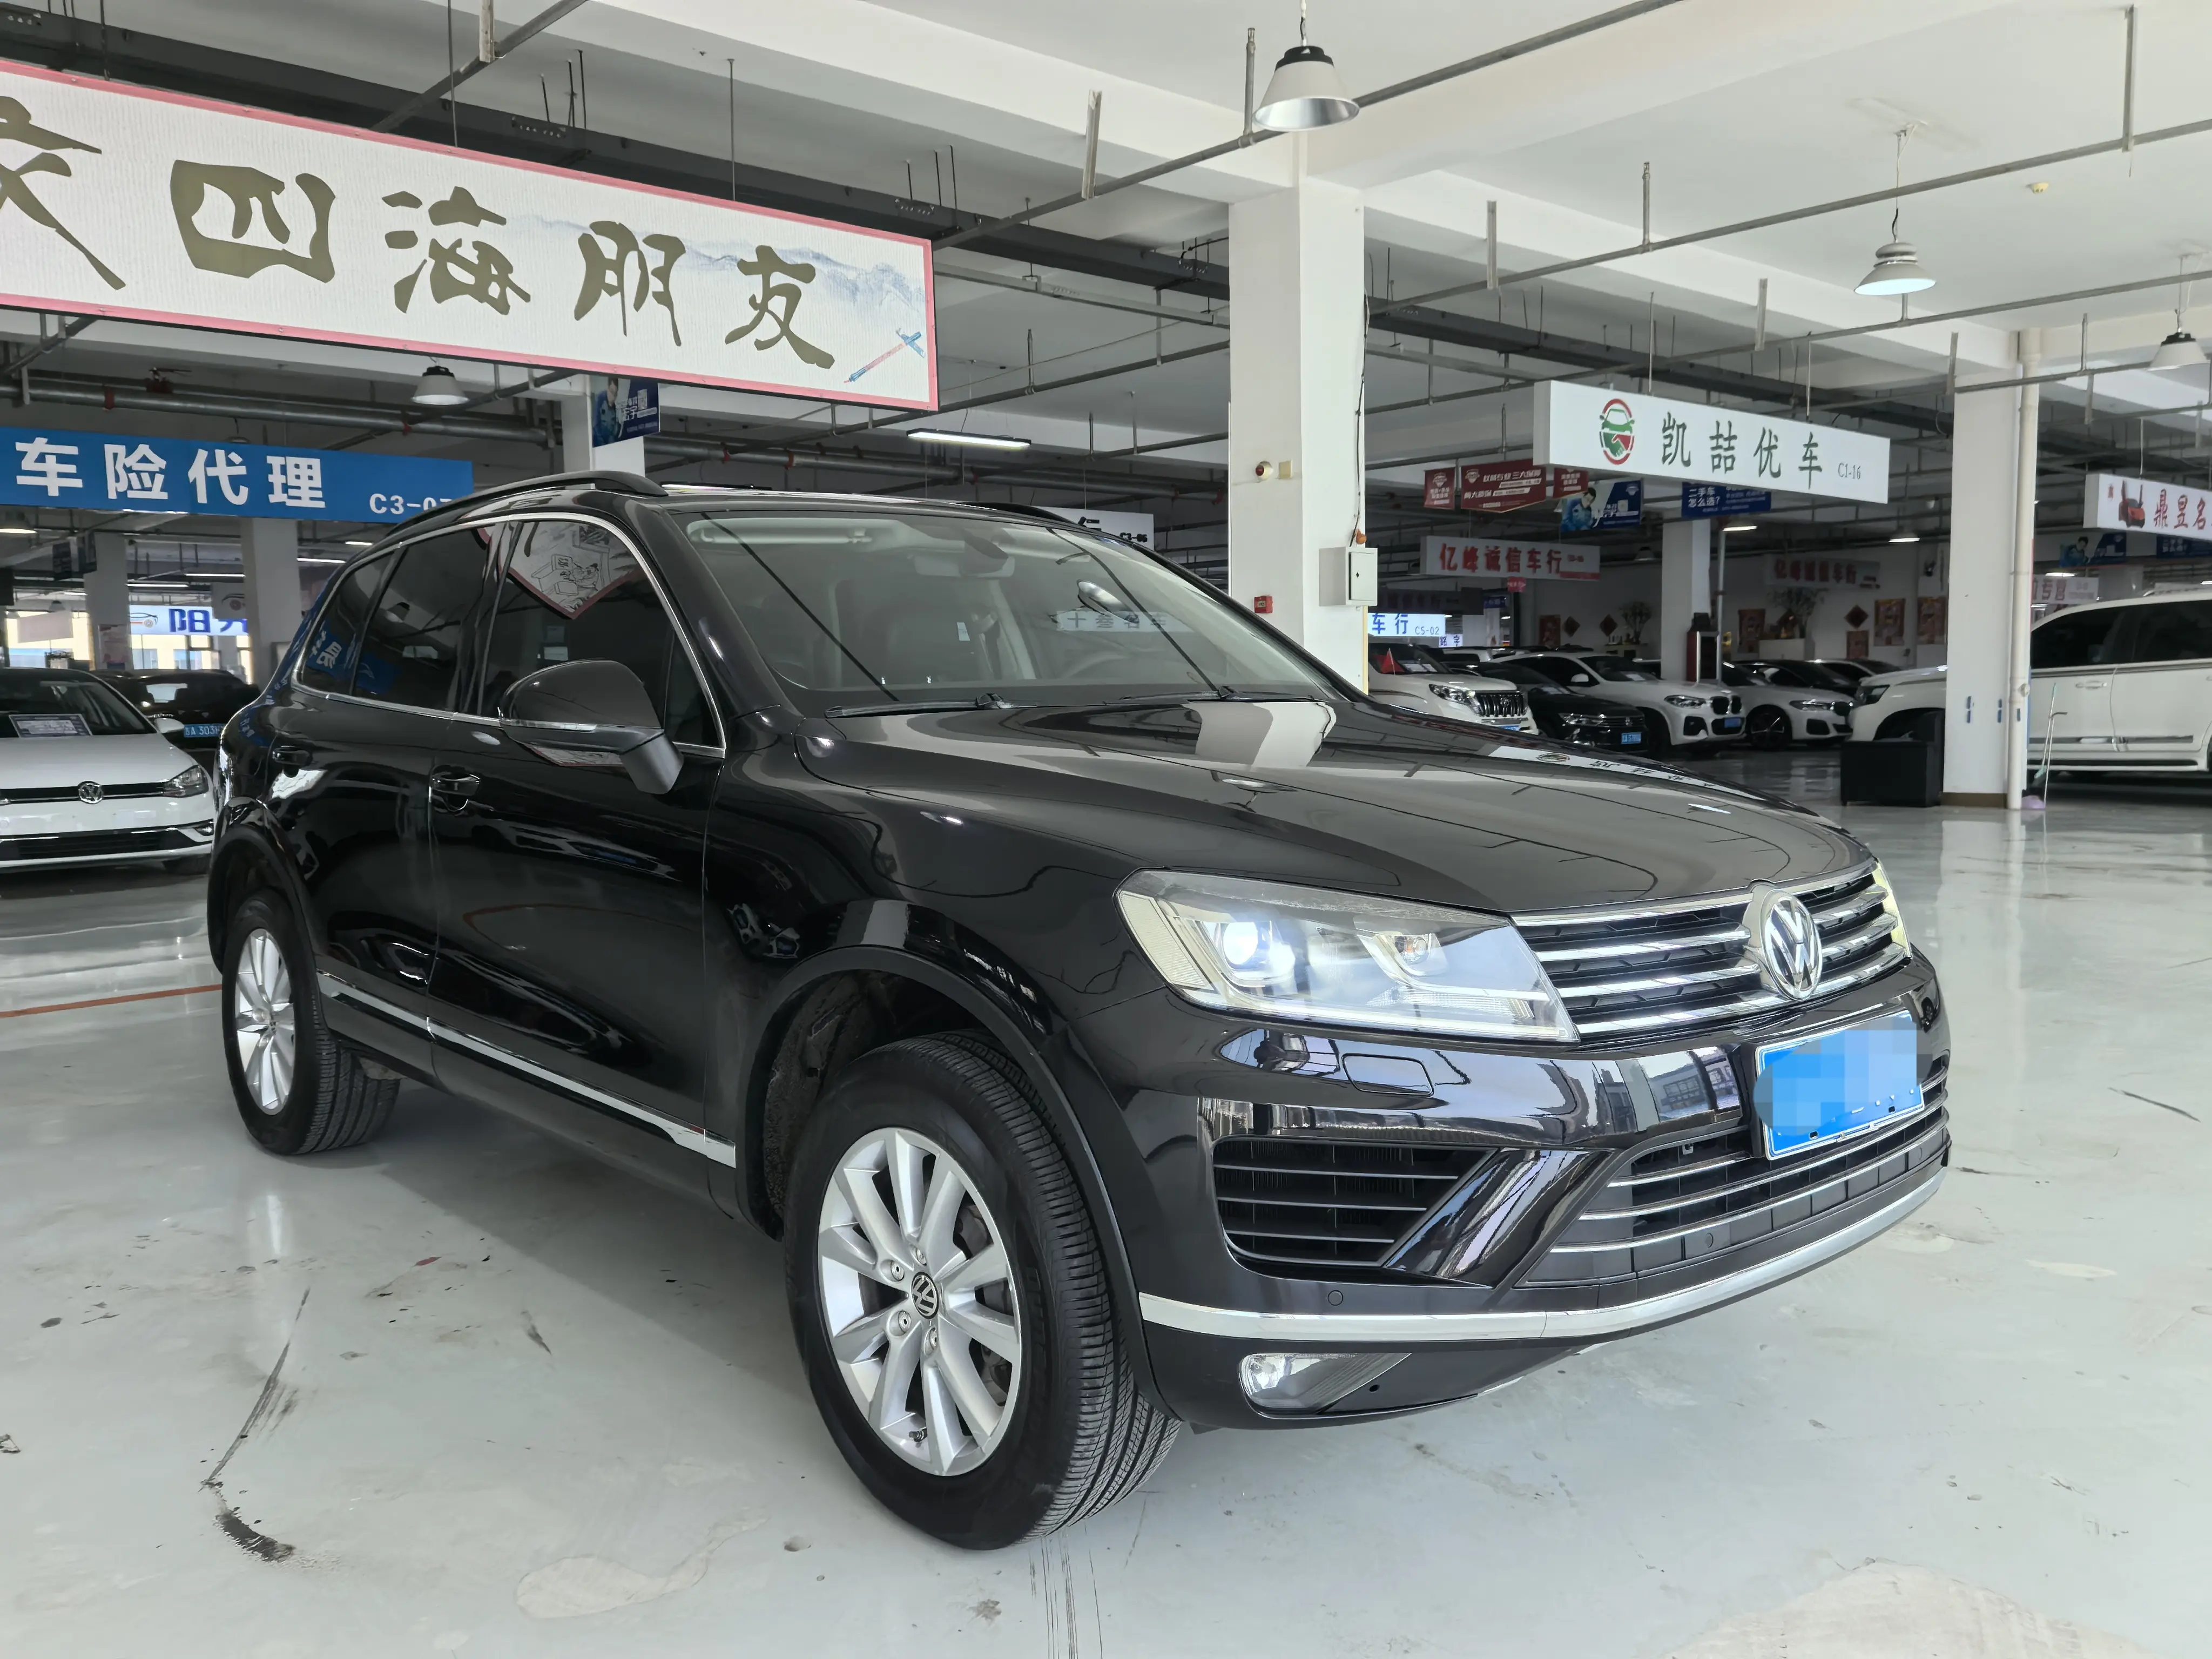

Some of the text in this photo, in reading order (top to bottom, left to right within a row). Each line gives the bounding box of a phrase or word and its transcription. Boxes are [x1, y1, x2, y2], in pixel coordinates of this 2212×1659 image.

[15, 437, 453, 515] 车险代理 C3-0
[1661, 412, 1861, 489] 凯喆优车 C1-16
[1372, 613, 1440, 635] 车行 C5-02
